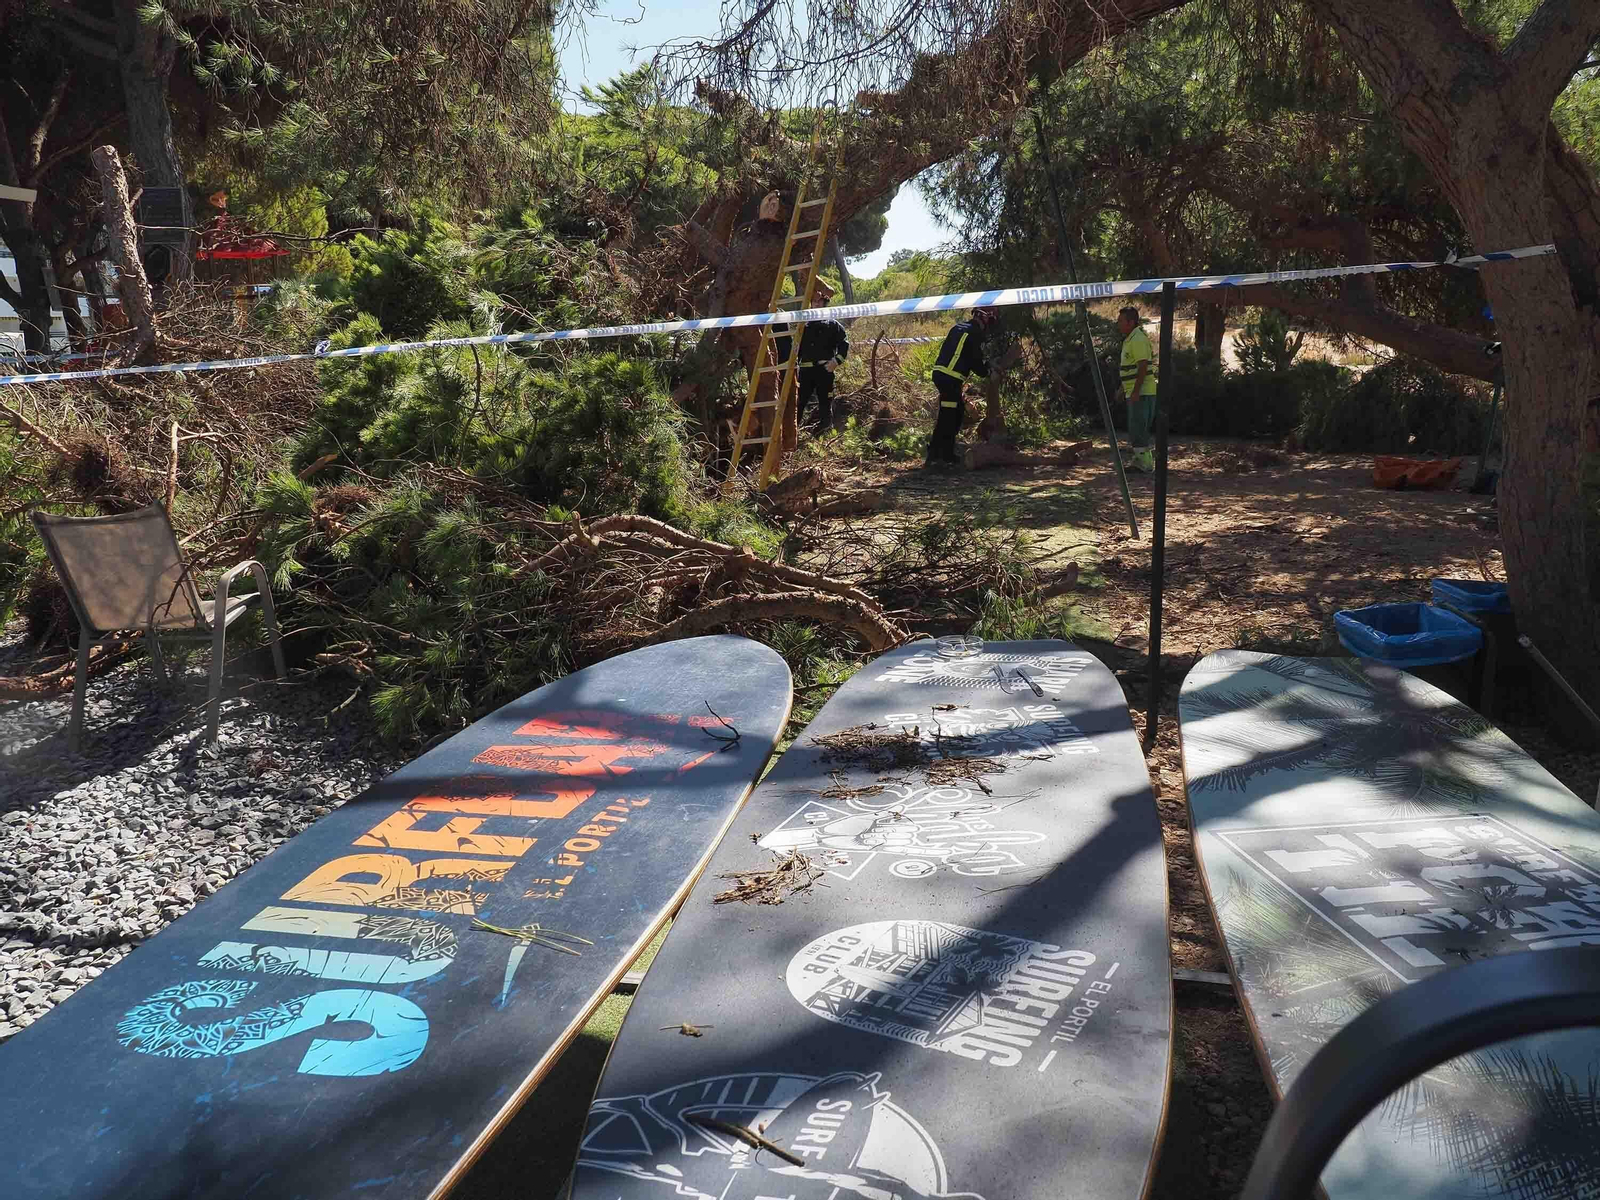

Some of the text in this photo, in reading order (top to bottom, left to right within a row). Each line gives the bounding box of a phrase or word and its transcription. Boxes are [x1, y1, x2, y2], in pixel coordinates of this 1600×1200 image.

[802, 935, 862, 976] CLUB
[950, 942, 1097, 1067] SURFING
[1050, 980, 1113, 1043] EL PORTIL
[789, 1097, 853, 1161] SURF
